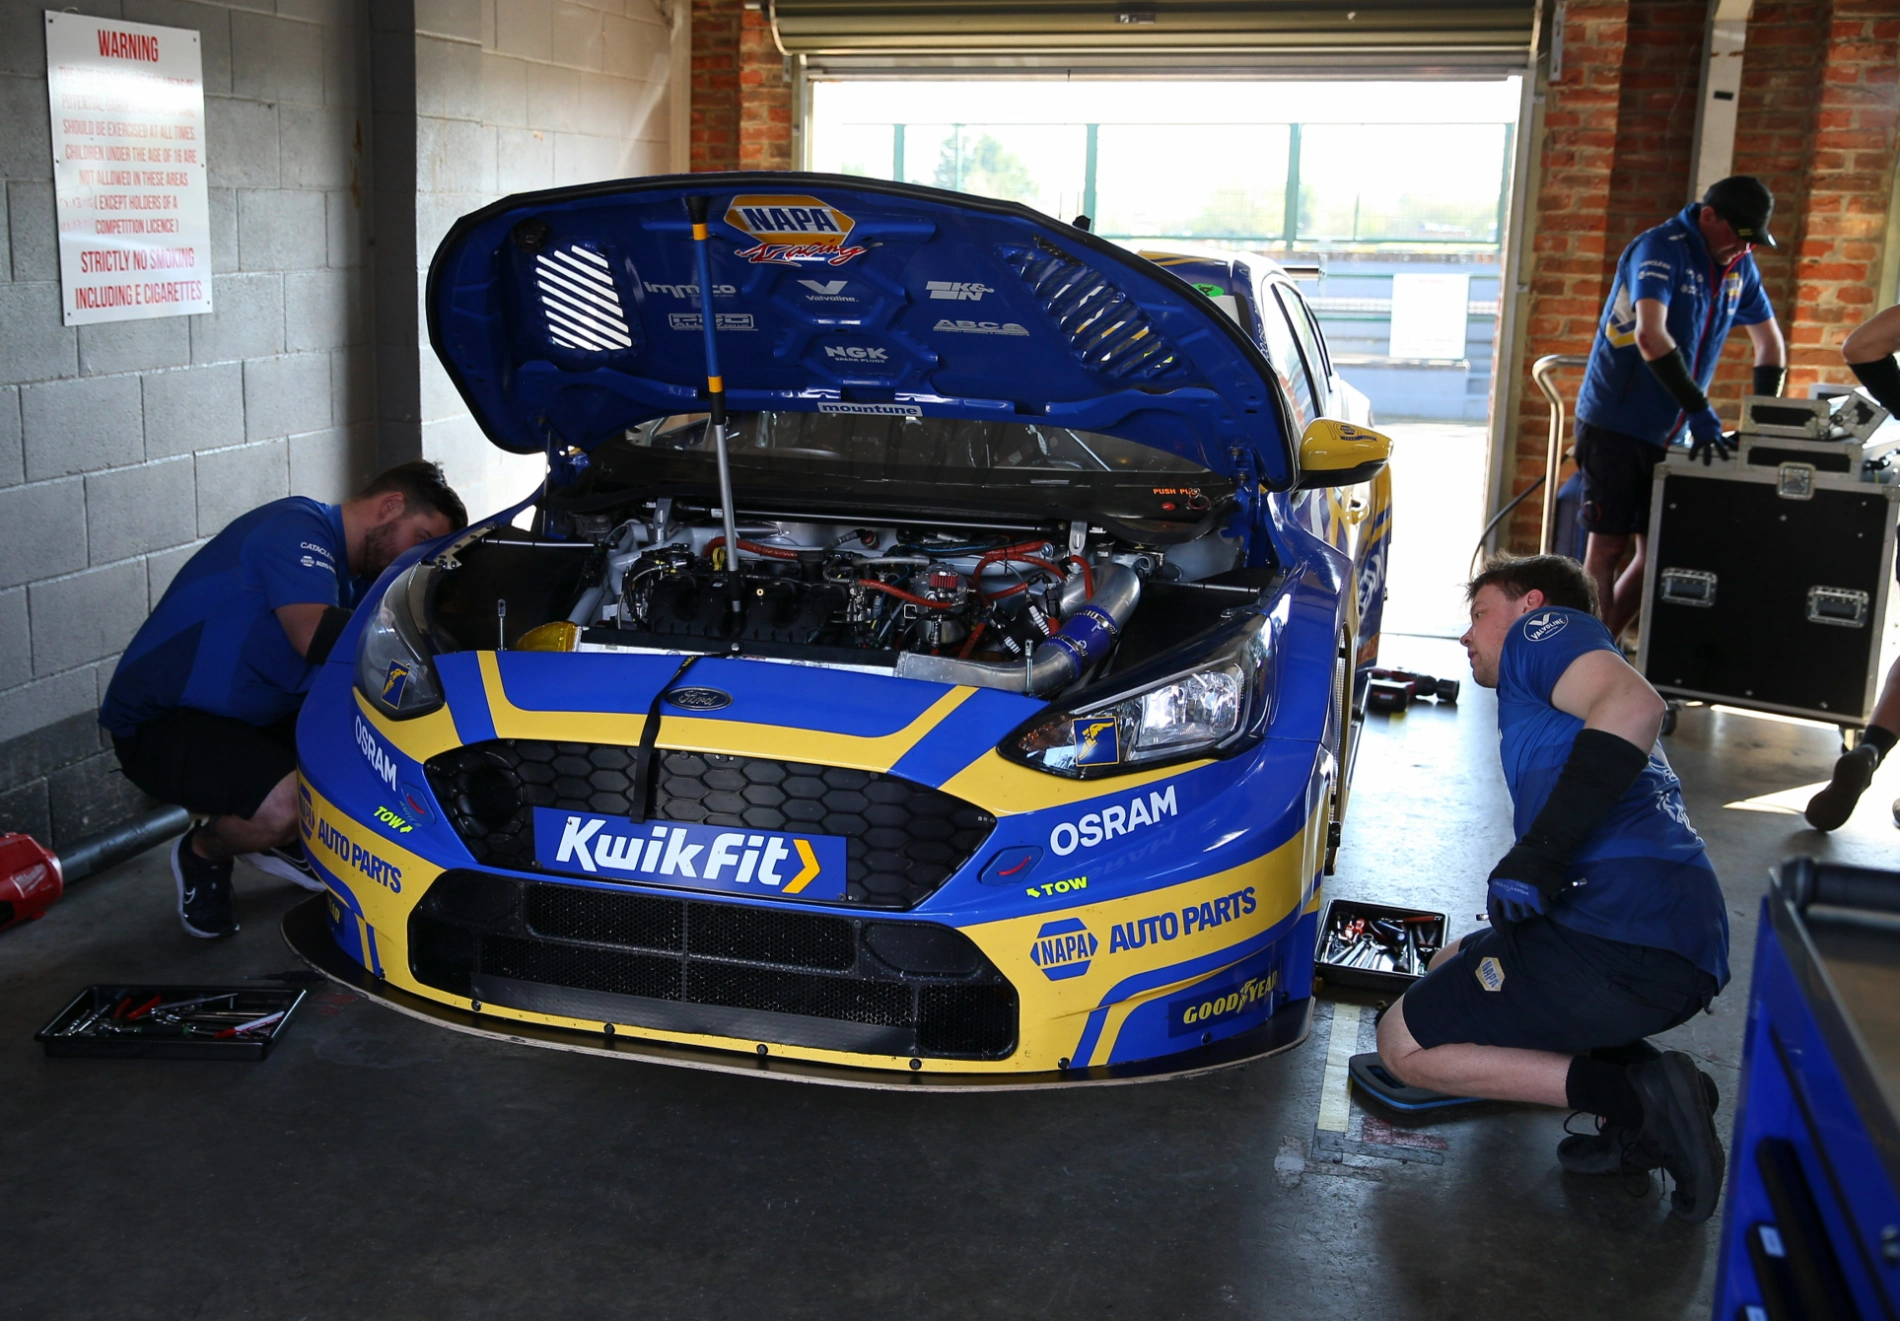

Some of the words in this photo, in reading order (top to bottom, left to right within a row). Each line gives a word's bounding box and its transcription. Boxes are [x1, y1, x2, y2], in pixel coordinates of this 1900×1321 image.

[97, 29, 160, 63] WARNING
[63, 118, 94, 135] SHOULD
[96, 121, 105, 136] BE
[107, 121, 148, 138] EXERCISED
[150, 124, 158, 138] AT
[160, 124, 173, 140] ALL
[174, 125, 196, 141] TIMES.
[65, 144, 104, 160] CHILDREN
[105, 146, 131, 161] UNDER
[132, 147, 146, 162] THE
[148, 148, 162, 163] AGE
[163, 149, 172, 163] OF
[174, 149, 182, 163] 16
[184, 149, 197, 164] ARE
[79, 169, 94, 186] NOT
[97, 170, 131, 186] ALLOWED
[133, 171, 141, 186] IN
[142, 171, 164, 187] THESE
[166, 171, 188, 187] AREAS
[129, 195, 161, 210] HOLDERS
[163, 195, 171, 210] OF
[173, 195, 179, 210] A
[96, 219, 145, 235] COMPETITION
[742, 207, 839, 233] NAPA
[81, 250, 130, 273] STRICTLY
[133, 250, 147, 270] NO
[150, 247, 195, 270] SMOKING
[734, 238, 868, 267] Racing
[75, 284, 132, 310] INCLUDING
[135, 284, 141, 305] E
[144, 280, 203, 305] CIGARETTES
[805, 294, 856, 303] Valvoline
[824, 345, 889, 360] NGK
[822, 403, 918, 416] mountune
[1530, 617, 1566, 640] VALVOLINE
[679, 690, 717, 706] Ford
[355, 715, 397, 792] OSRAM
[373, 805, 405, 829] TOW
[1050, 785, 1178, 856] OSRAM
[317, 817, 350, 862] AUTO
[351, 842, 402, 894] PARTS
[1041, 876, 1088, 896] TOW
[1040, 935, 1089, 965] NAPA
[1109, 911, 1179, 954] AUTO
[1183, 886, 1257, 936] PARTS
[1481, 961, 1500, 988] NAPA
[1183, 969, 1278, 1025] GOODYEAR
